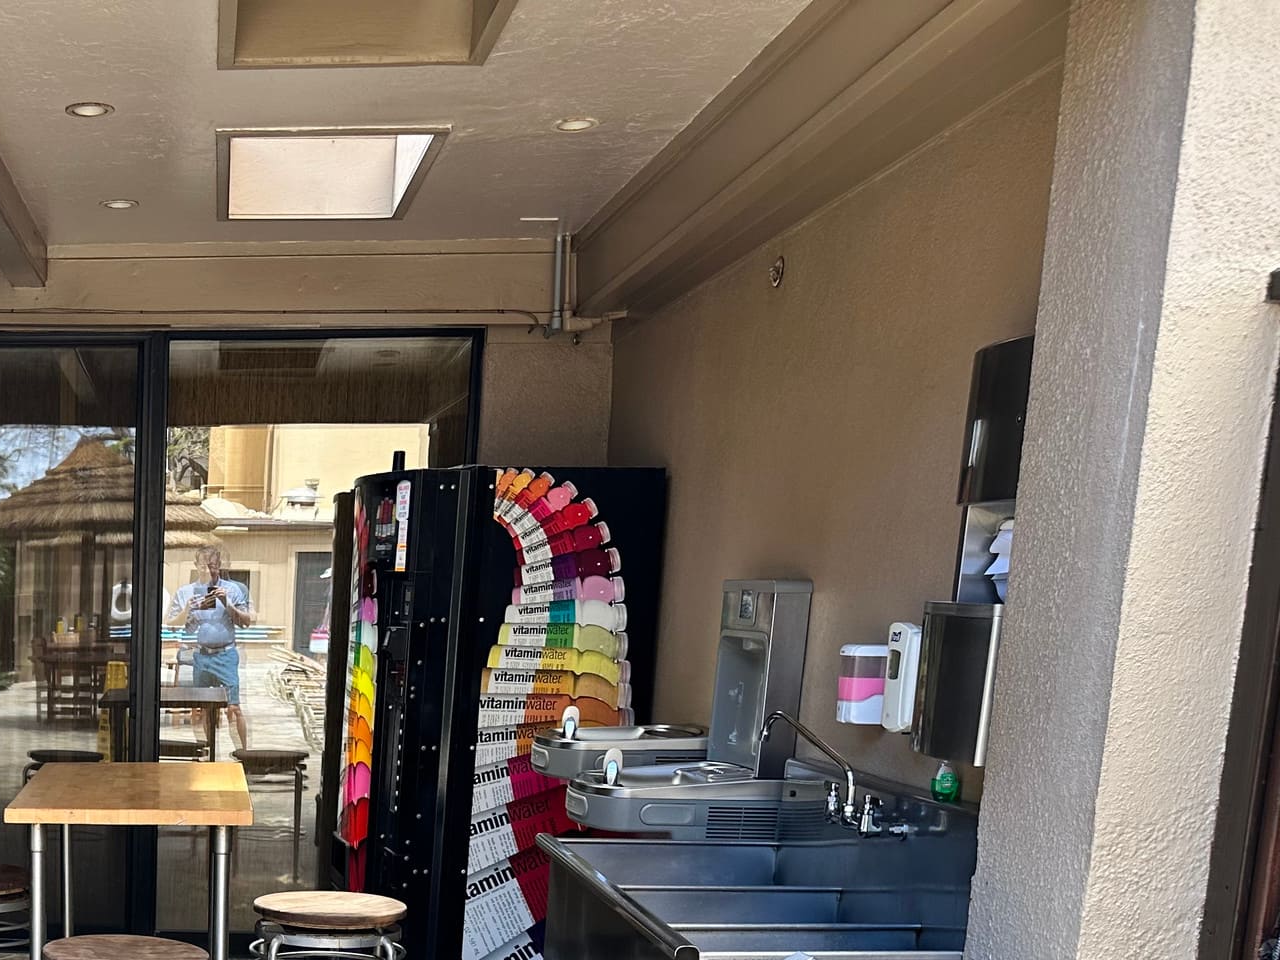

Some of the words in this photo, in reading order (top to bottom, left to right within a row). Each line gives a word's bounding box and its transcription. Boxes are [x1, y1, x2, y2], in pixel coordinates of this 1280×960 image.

[513, 625, 569, 635] vitaminwater
[505, 647, 567, 660] vitaminwater
[494, 671, 562, 684] vitaminwater
[479, 697, 558, 710] vitaminwater
[469, 800, 550, 836] aminwater
